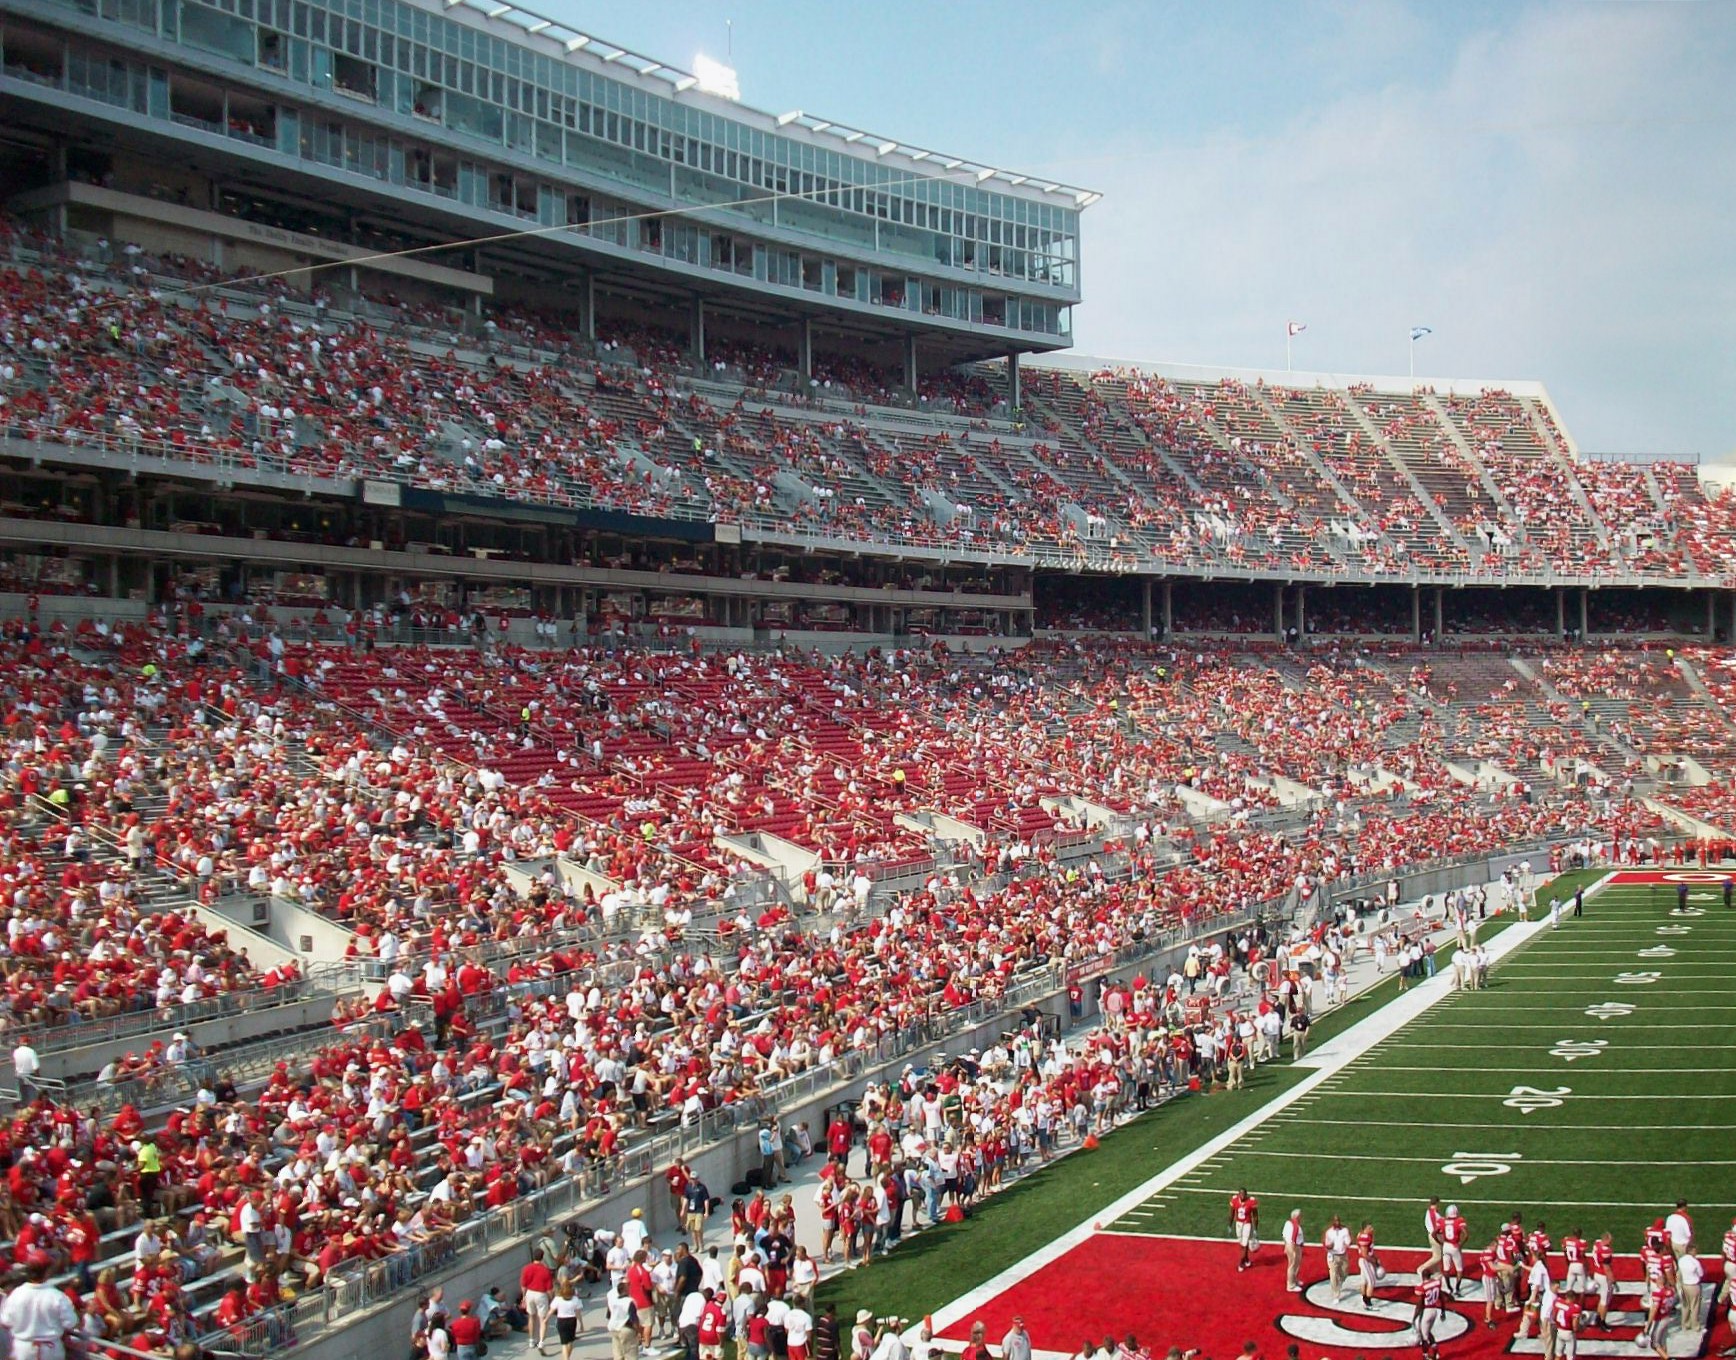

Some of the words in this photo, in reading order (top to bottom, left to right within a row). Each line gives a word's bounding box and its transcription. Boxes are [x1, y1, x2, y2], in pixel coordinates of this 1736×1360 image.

[1548, 1039, 1609, 1056] 30
[1502, 1085, 1573, 1107] 20
[1440, 1151, 1523, 1176] 10
[1424, 1288, 1441, 1306] 20
[701, 1311, 714, 1332] 2
